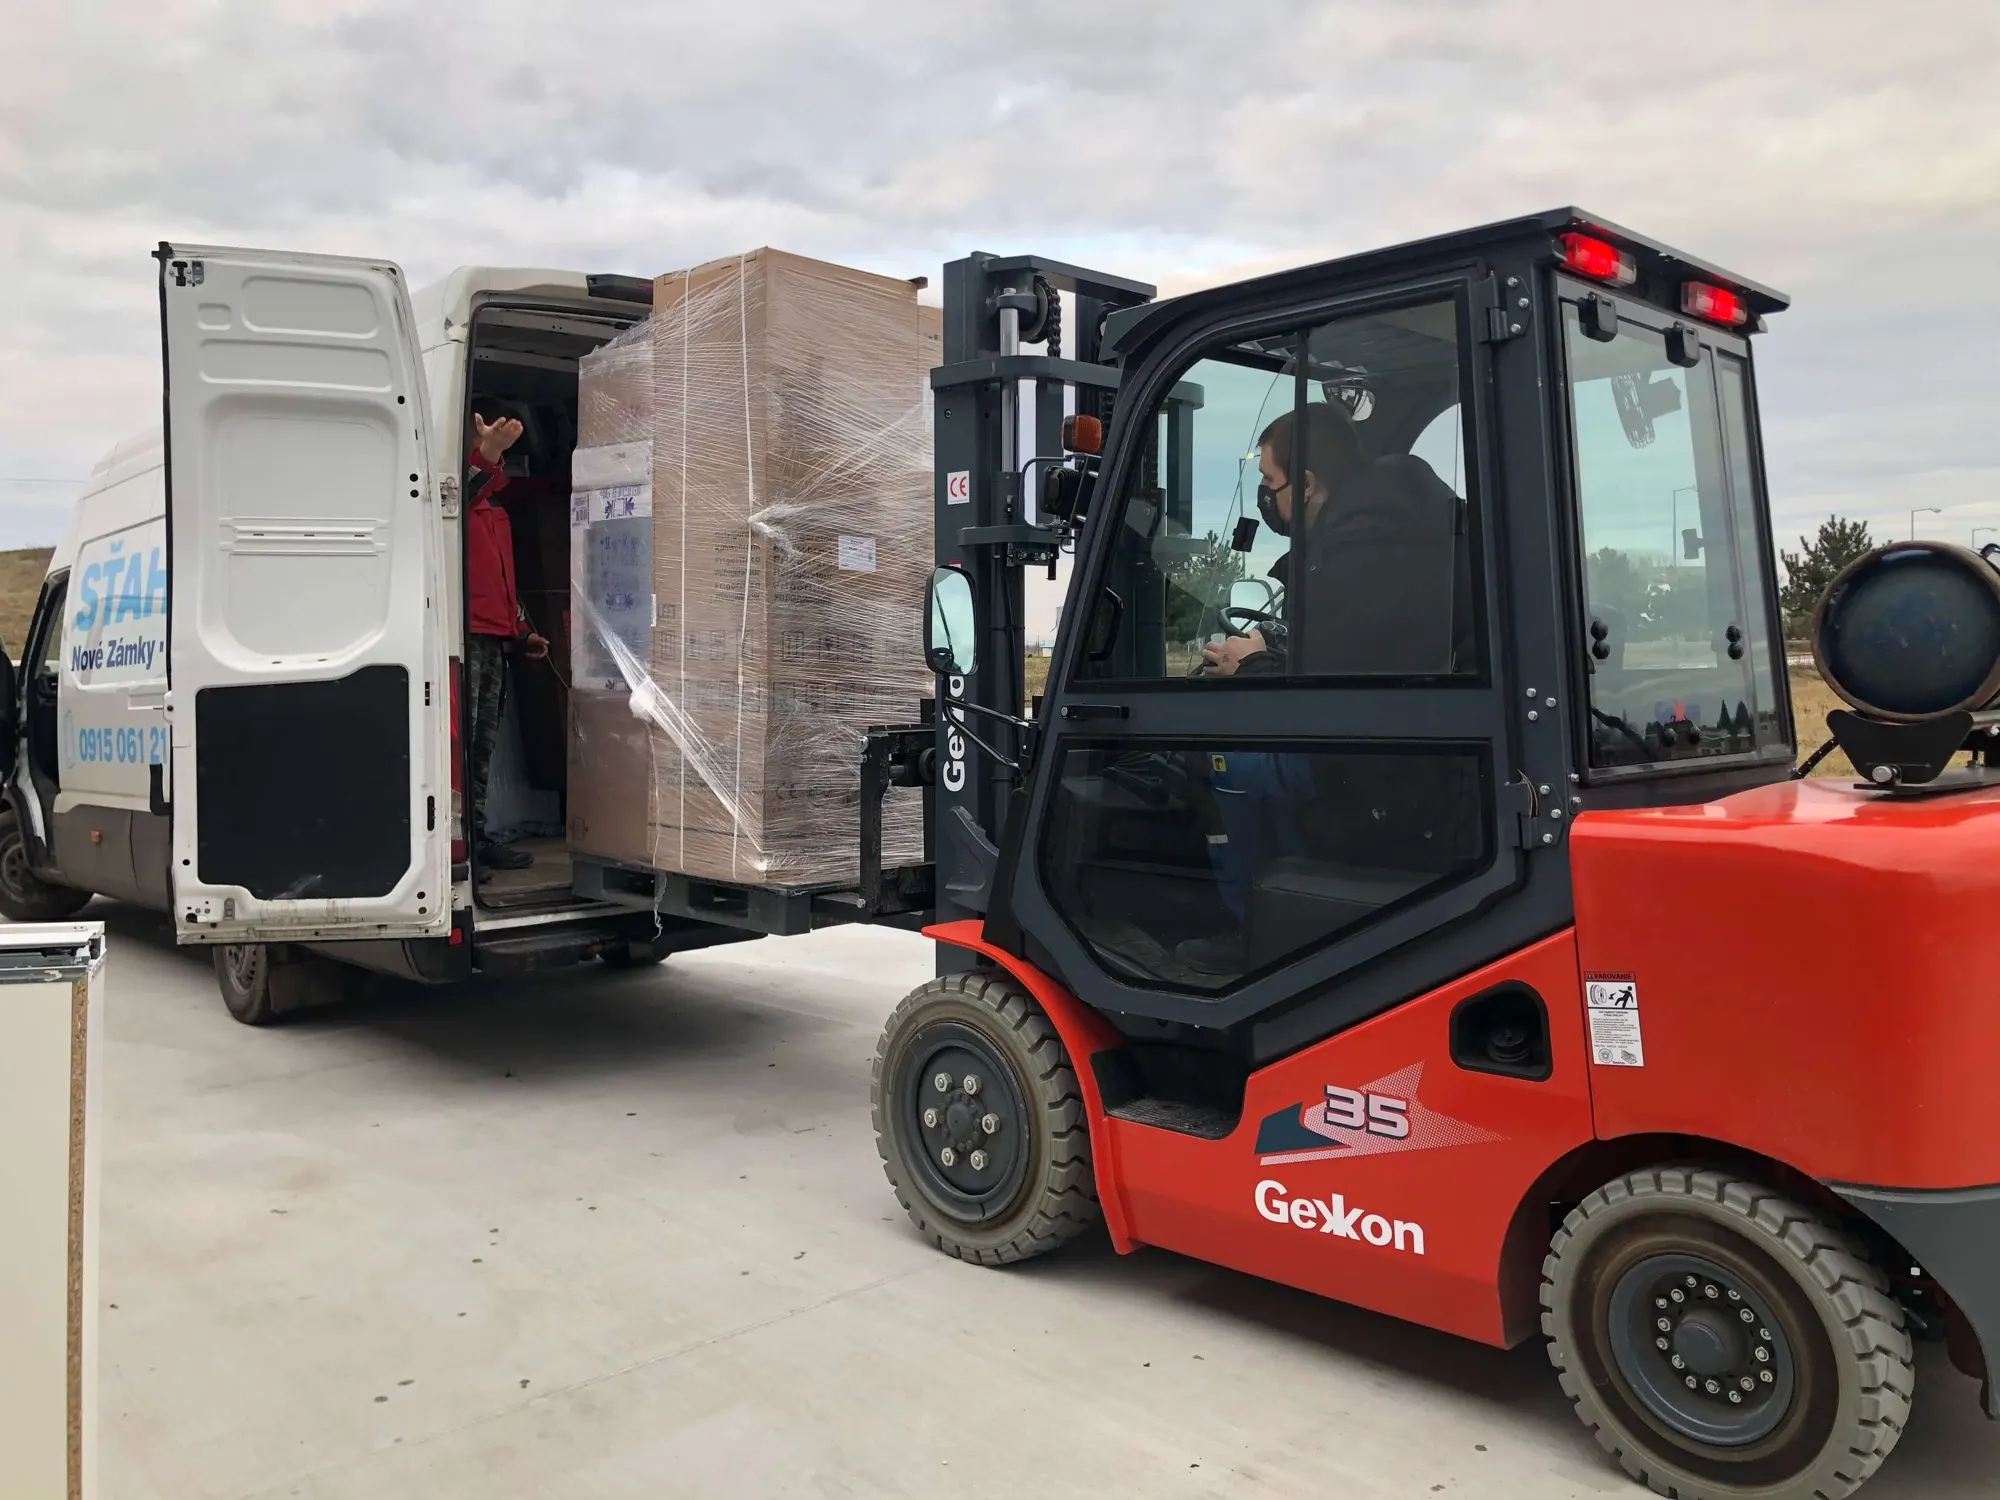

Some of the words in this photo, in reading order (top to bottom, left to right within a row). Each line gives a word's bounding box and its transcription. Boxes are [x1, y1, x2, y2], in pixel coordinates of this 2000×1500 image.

[949, 475, 967, 497] CE
[71, 641, 104, 672] Nové
[106, 635, 156, 671] Zámky
[80, 727, 113, 763] 0915
[116, 727, 145, 764] 061
[1593, 972, 1633, 980] VAROVANIE
[1323, 1084, 1410, 1140] 35
[1254, 1179, 1425, 1256] Gekkon
